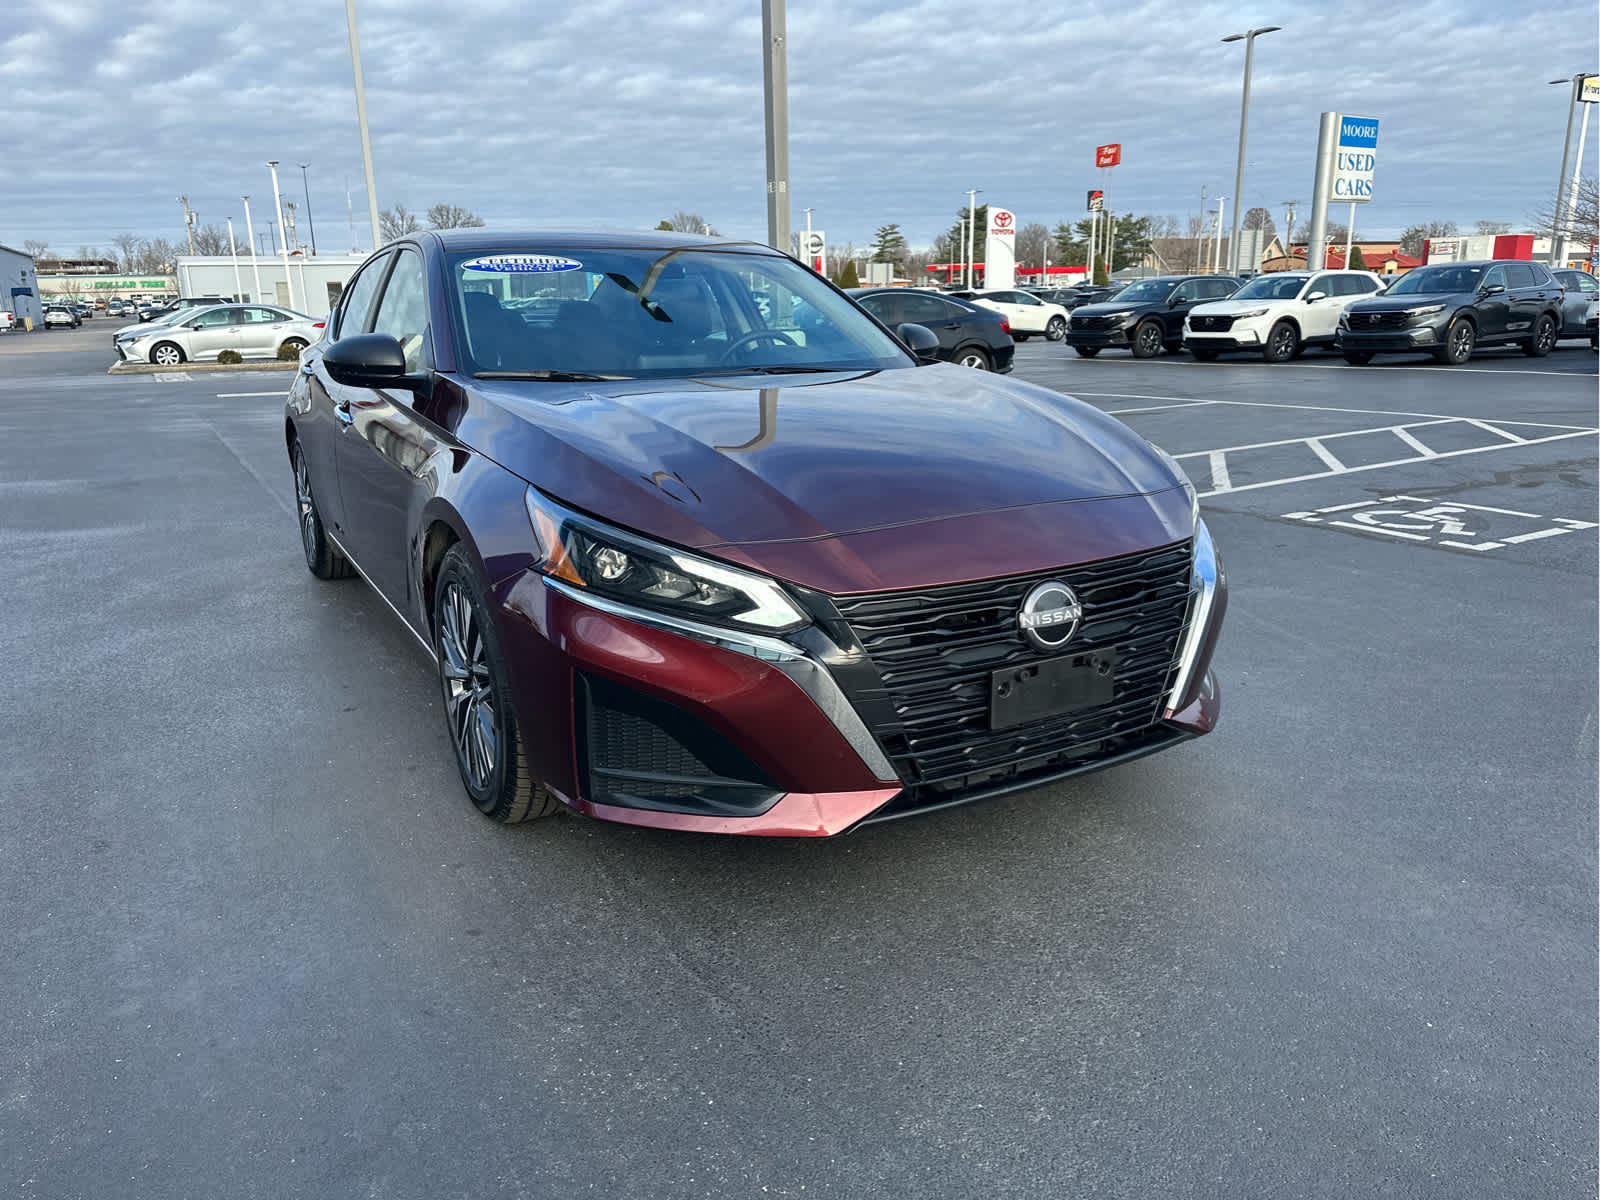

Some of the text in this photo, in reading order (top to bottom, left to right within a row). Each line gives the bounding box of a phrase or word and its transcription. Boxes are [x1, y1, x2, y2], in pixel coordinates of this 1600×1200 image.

[1342, 124, 1376, 138] MOORE
[1338, 153, 1375, 171] USED
[1335, 178, 1372, 196] CARS
[1022, 606, 1081, 626] NISSAN
